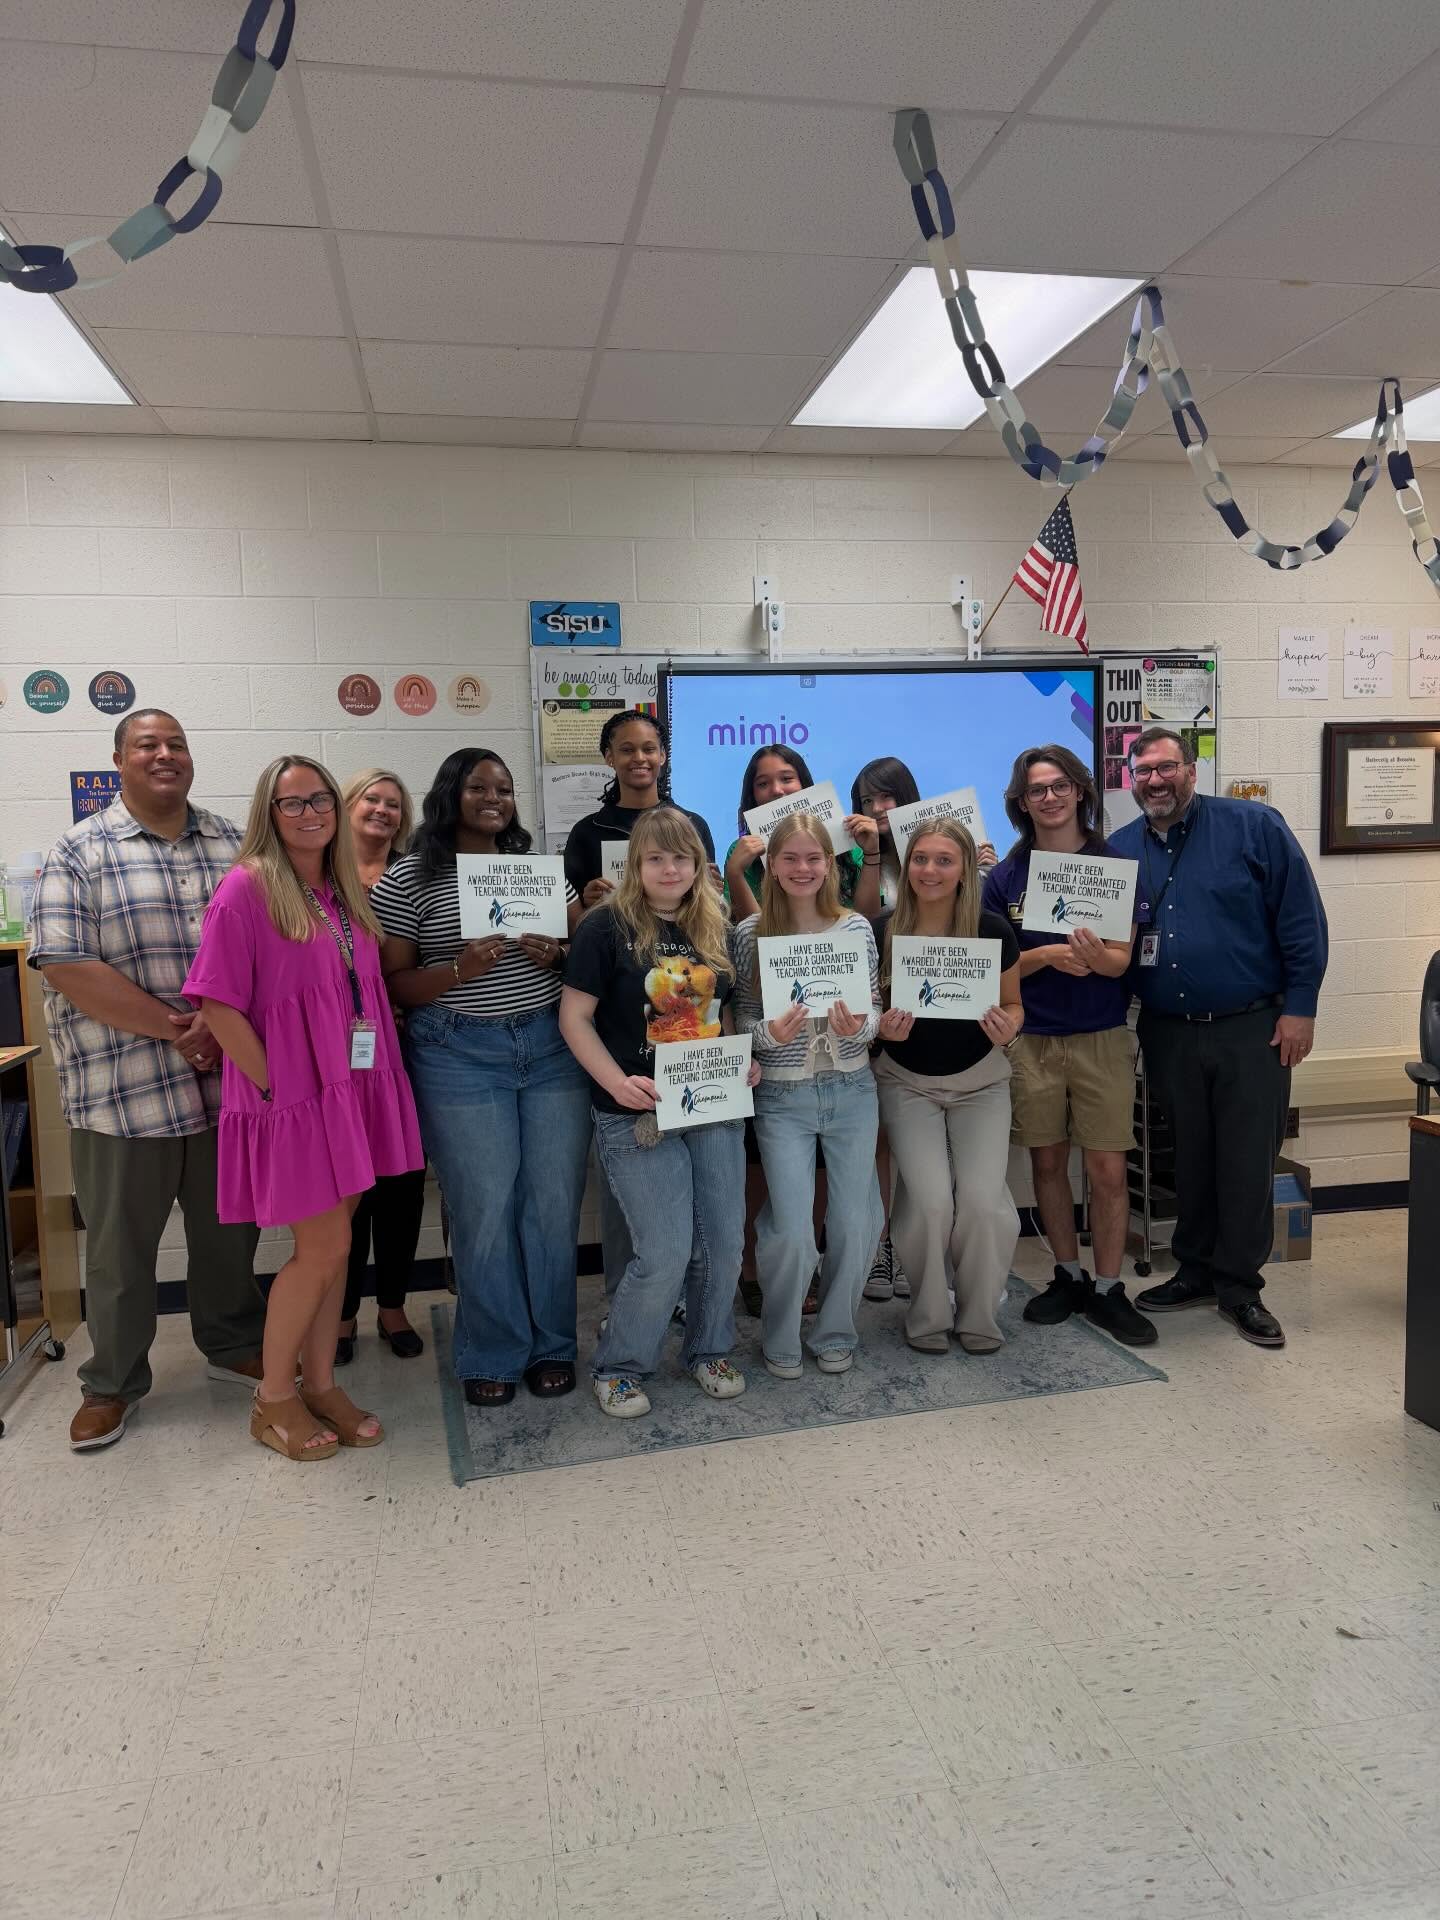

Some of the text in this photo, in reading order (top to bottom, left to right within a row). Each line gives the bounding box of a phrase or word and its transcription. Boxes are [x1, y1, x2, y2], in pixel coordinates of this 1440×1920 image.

[546, 614, 605, 634] SISU
[544, 661, 559, 684] be
[562, 665, 619, 696] amazing
[708, 715, 809, 746] mimio
[776, 805, 793, 818] HAVE
[793, 798, 810, 811] BEEN
[918, 806, 935, 818] HAVE
[936, 802, 952, 813] BEEN
[493, 864, 512, 875] HAVE
[514, 864, 532, 875] BEEN
[1064, 863, 1082, 874] HAVE
[1084, 865, 1104, 877] BEEN
[468, 875, 556, 886] AWARDED A GUARANTEED
[1037, 872, 1127, 890] AWARDED A GUARANTEED
[474, 886, 509, 897] TEACHING
[1042, 882, 1076, 895] TEACHING
[793, 944, 813, 955] HAVE
[814, 943, 834, 954] BEEN
[927, 946, 947, 956] HAVE
[948, 947, 968, 957] BEEN
[769, 952, 858, 968] AWARDED A GUARANTEED
[901, 956, 991, 969] AWARDED A GUARANTEED
[775, 966, 810, 979] TEACHING
[906, 967, 941, 978] TEACHING
[687, 1049, 705, 1060] HAVE
[706, 1047, 723, 1057] BEEN
[663, 1055, 744, 1074] AWARDED A GUARANTEED
[668, 1072, 700, 1086] TEACHING
